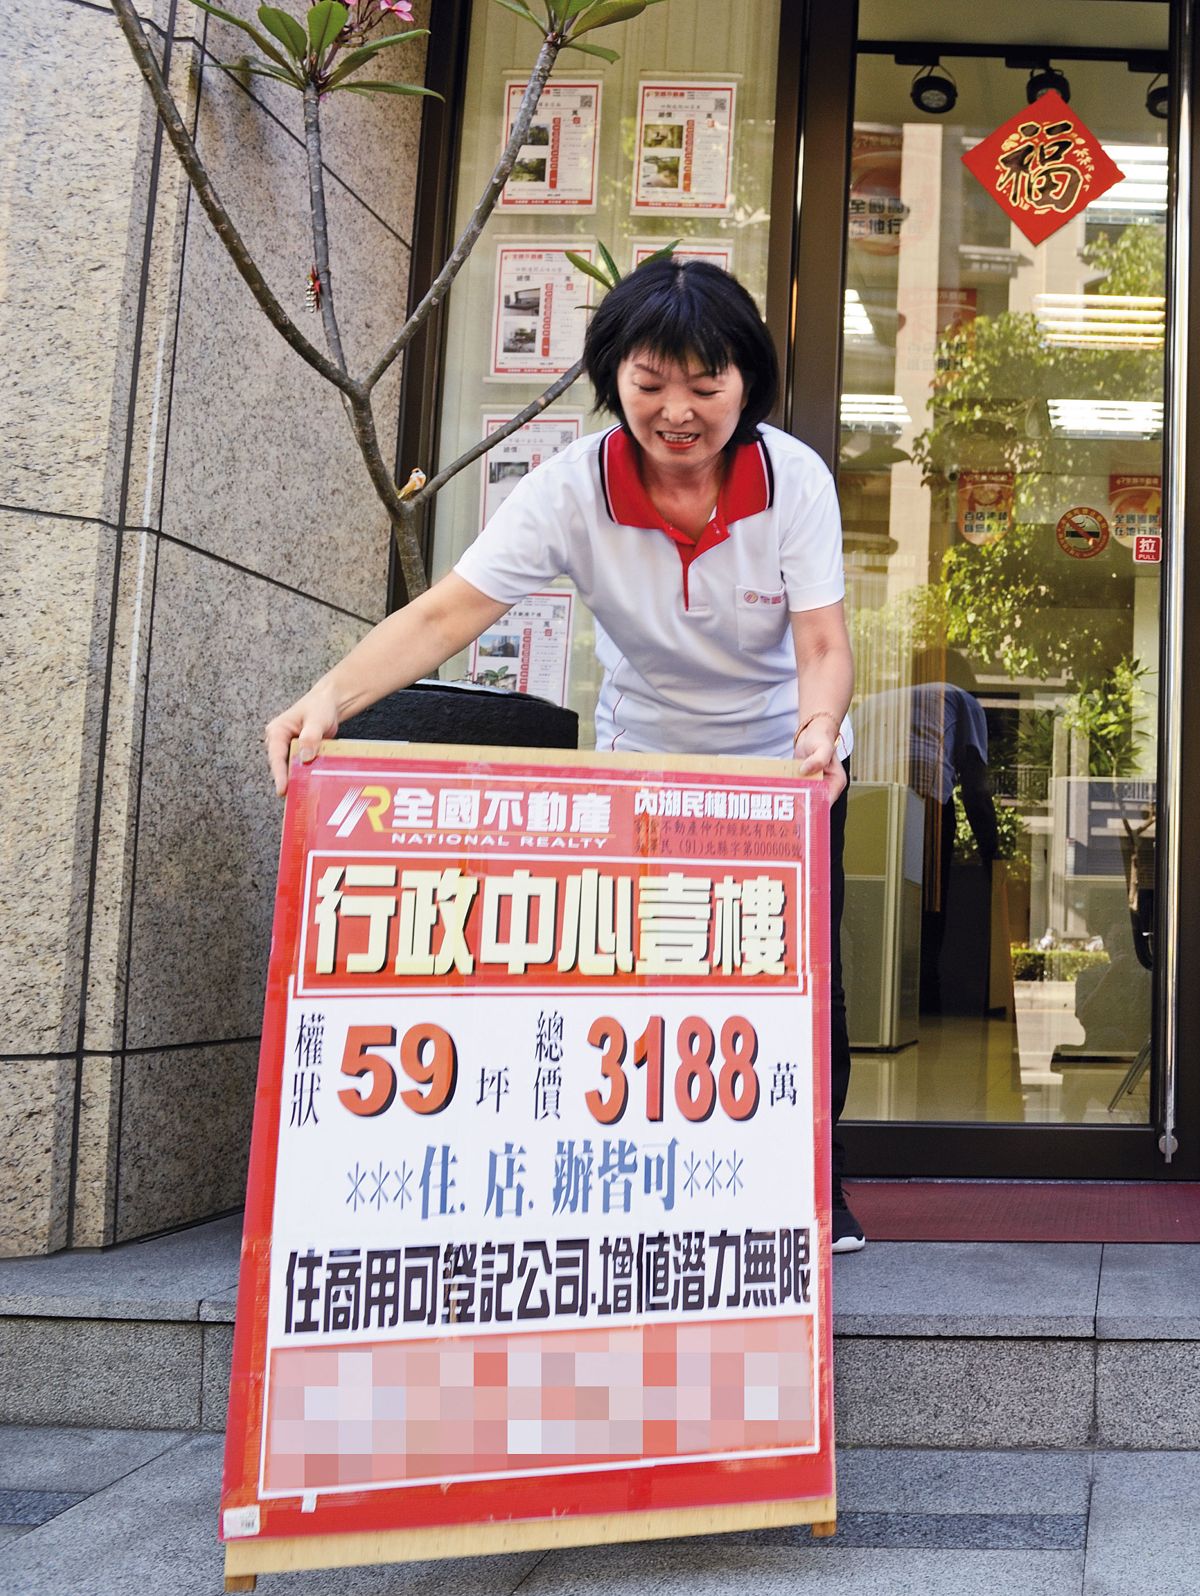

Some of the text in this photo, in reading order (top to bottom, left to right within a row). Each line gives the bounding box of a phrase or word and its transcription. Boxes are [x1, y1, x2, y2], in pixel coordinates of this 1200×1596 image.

[996, 120, 1083, 213] 福
[1139, 539, 1157, 553] 拉
[392, 787, 612, 833] 全國不動產
[634, 788, 795, 821] 內湖民權加盟店
[392, 832, 608, 849] NATIONAL REALTY
[314, 865, 787, 977] 行政中心壹樓
[288, 1010, 799, 1128] 權狀 59 坪 總價 3188 萬
